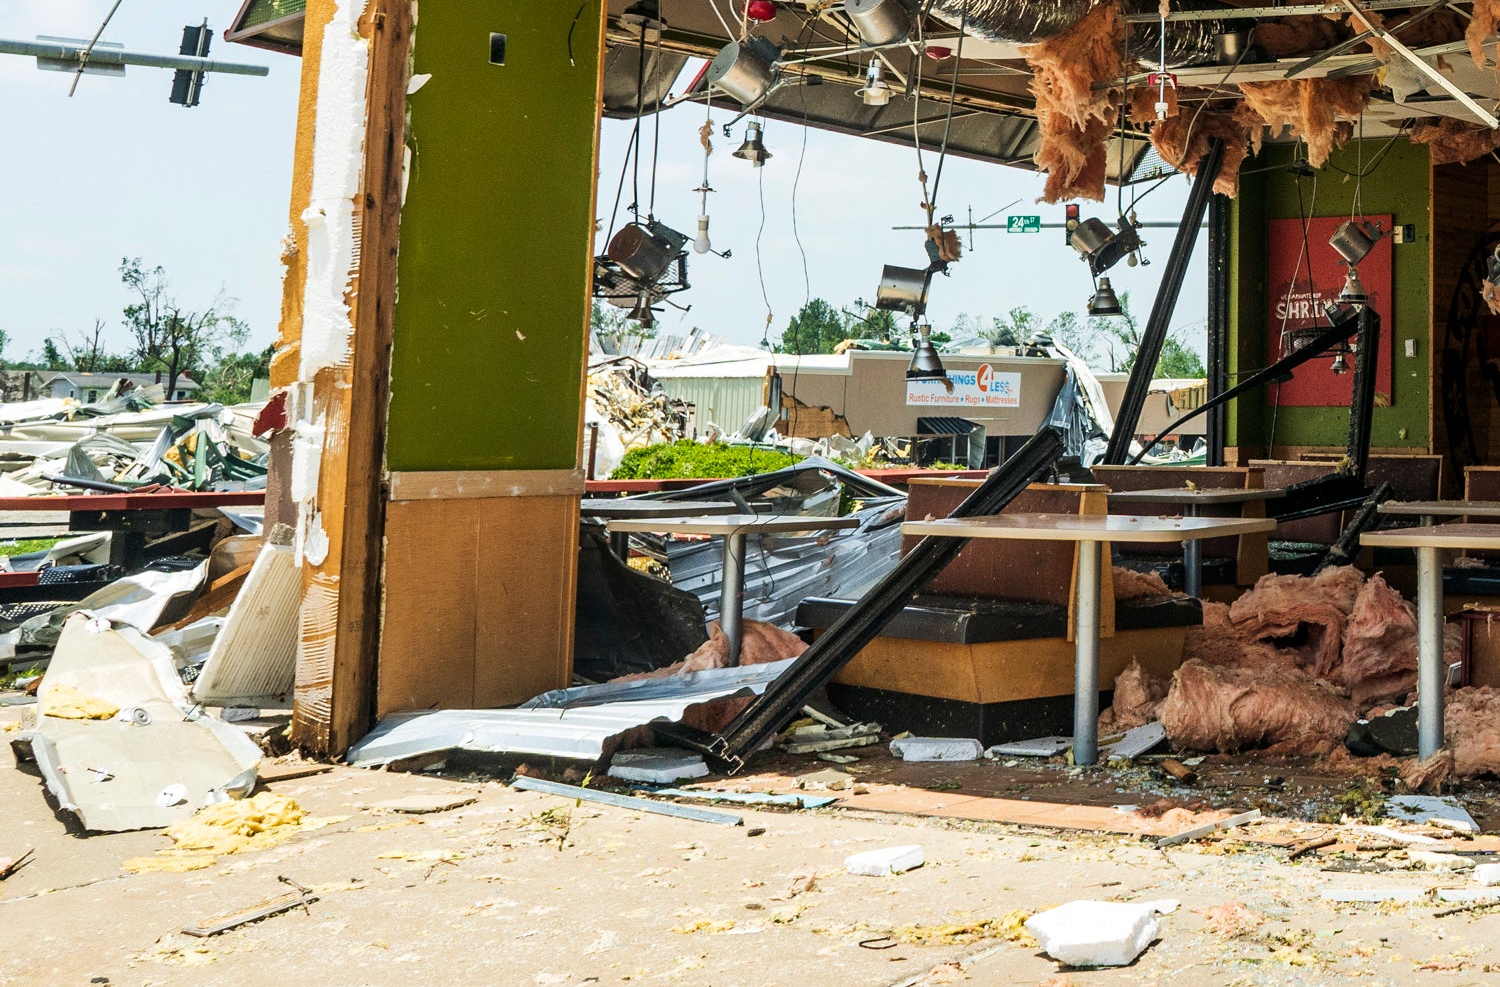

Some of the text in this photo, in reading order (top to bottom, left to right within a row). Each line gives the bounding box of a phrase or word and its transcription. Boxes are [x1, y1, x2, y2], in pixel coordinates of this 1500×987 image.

[1275, 300, 1333, 320] SHRIM
[977, 363, 995, 393] 4
[909, 393, 1018, 405] Rustic Furniture Rugs Mattresses
